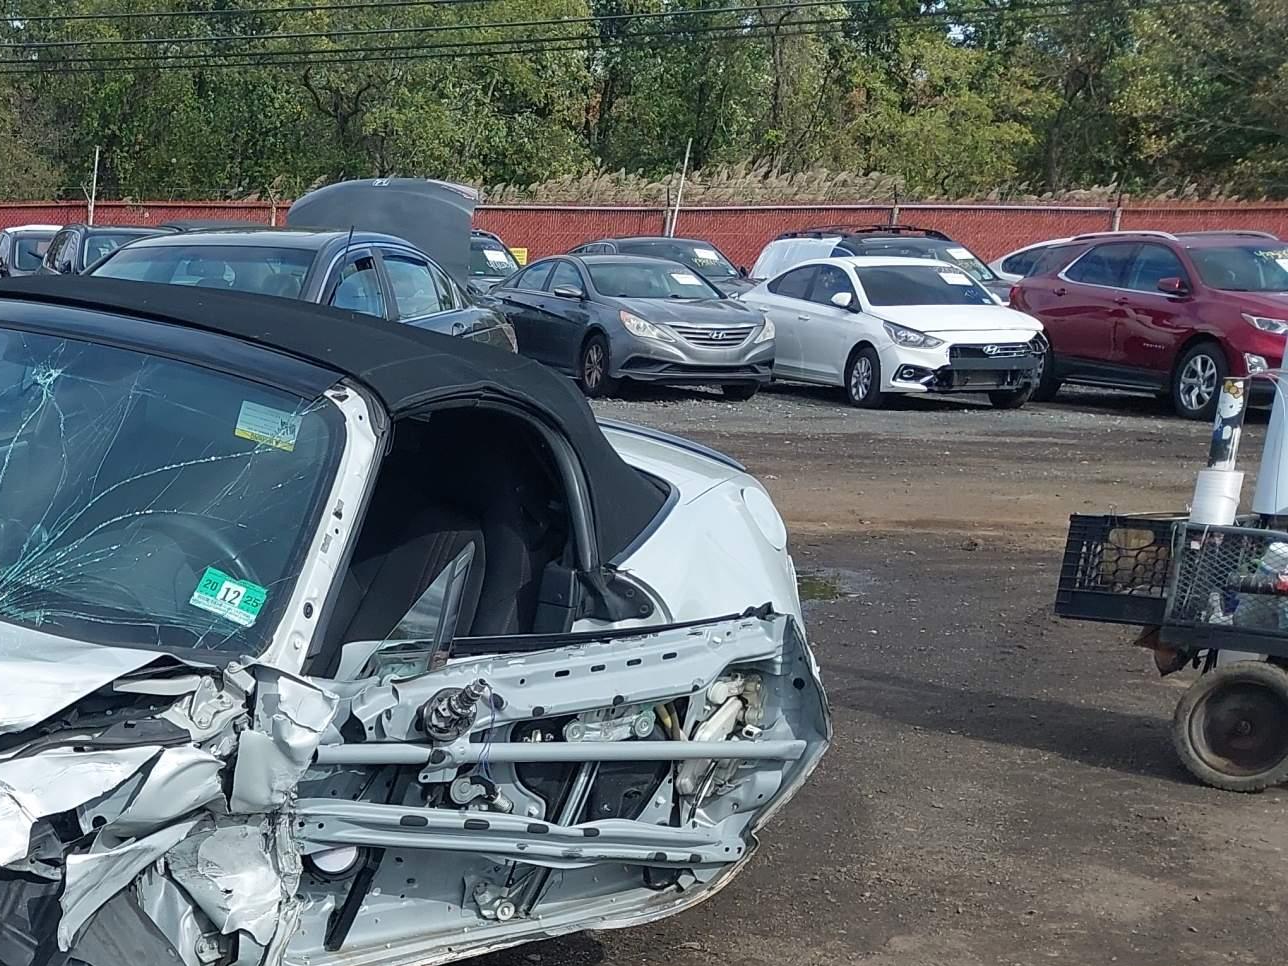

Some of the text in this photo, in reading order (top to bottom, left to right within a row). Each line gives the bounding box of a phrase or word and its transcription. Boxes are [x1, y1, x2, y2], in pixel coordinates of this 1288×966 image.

[203, 579, 260, 608] 20 12 25
